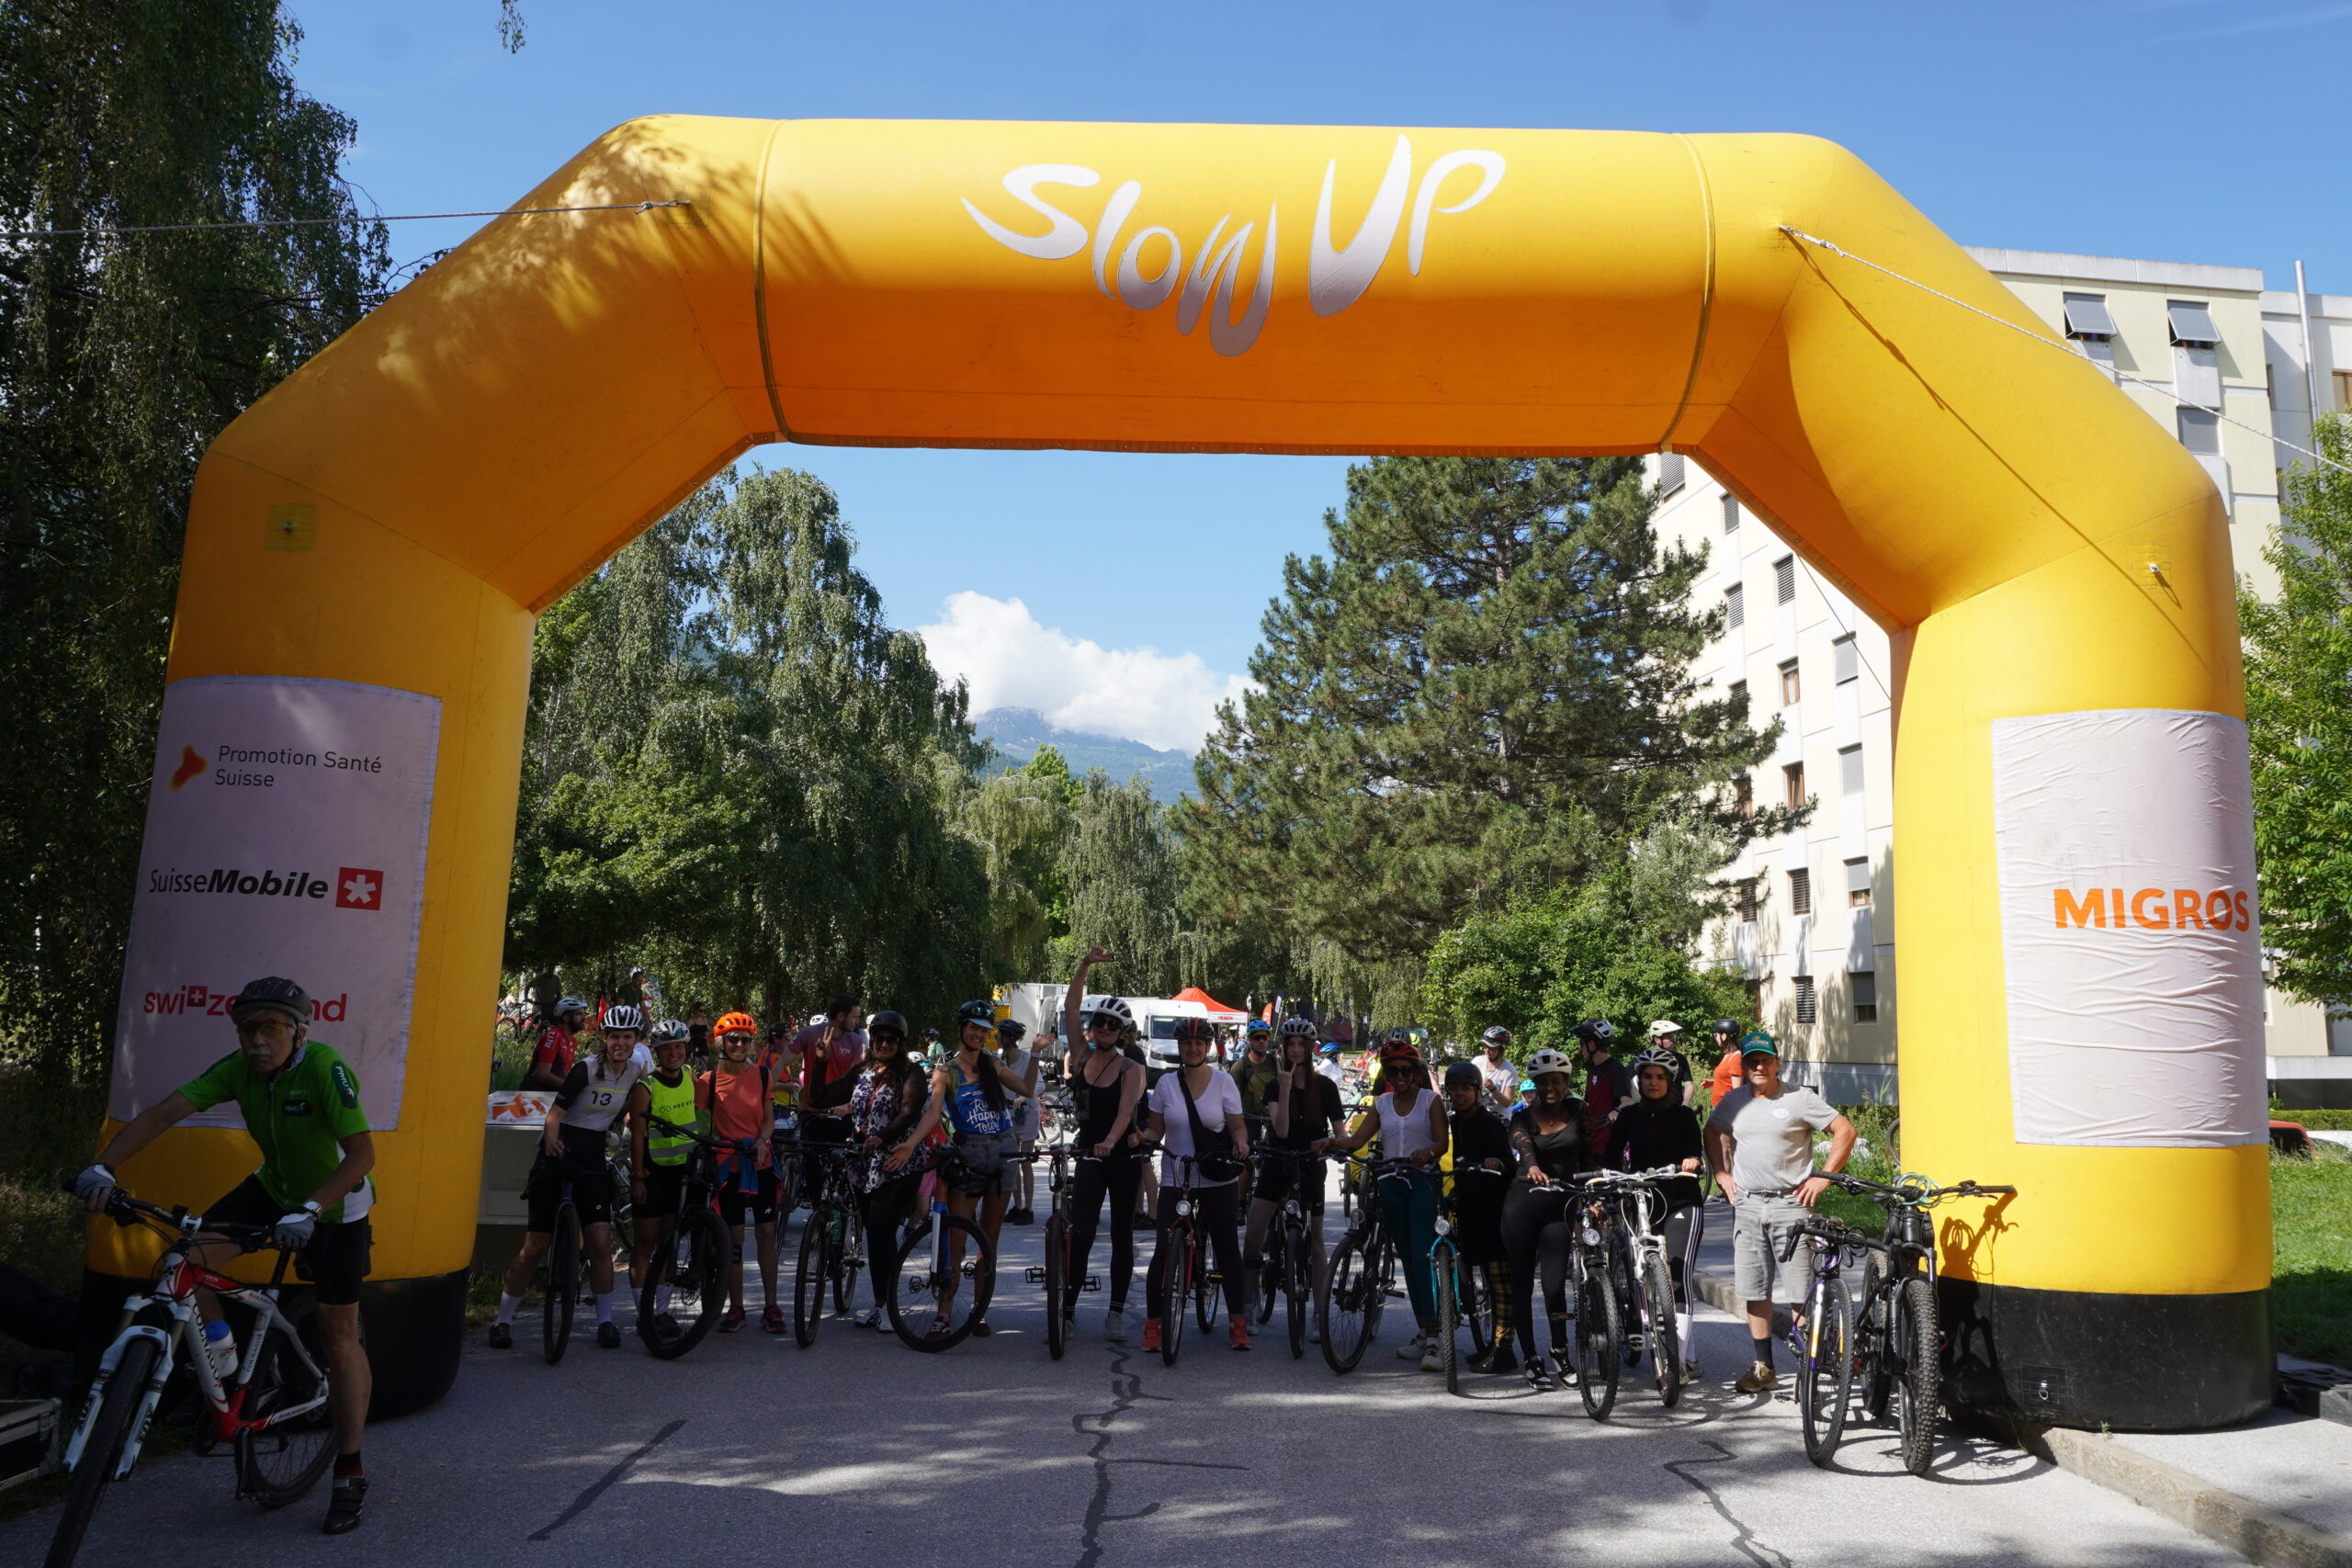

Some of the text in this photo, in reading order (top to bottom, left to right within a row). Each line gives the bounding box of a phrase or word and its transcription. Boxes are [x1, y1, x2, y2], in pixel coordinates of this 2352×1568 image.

[219, 745, 382, 773] Promotion Santé
[215, 768, 275, 787] Suisse
[149, 868, 328, 899] SuisseMobile
[2053, 887, 2250, 931] MIGROS
[591, 1090, 613, 1106] 13
